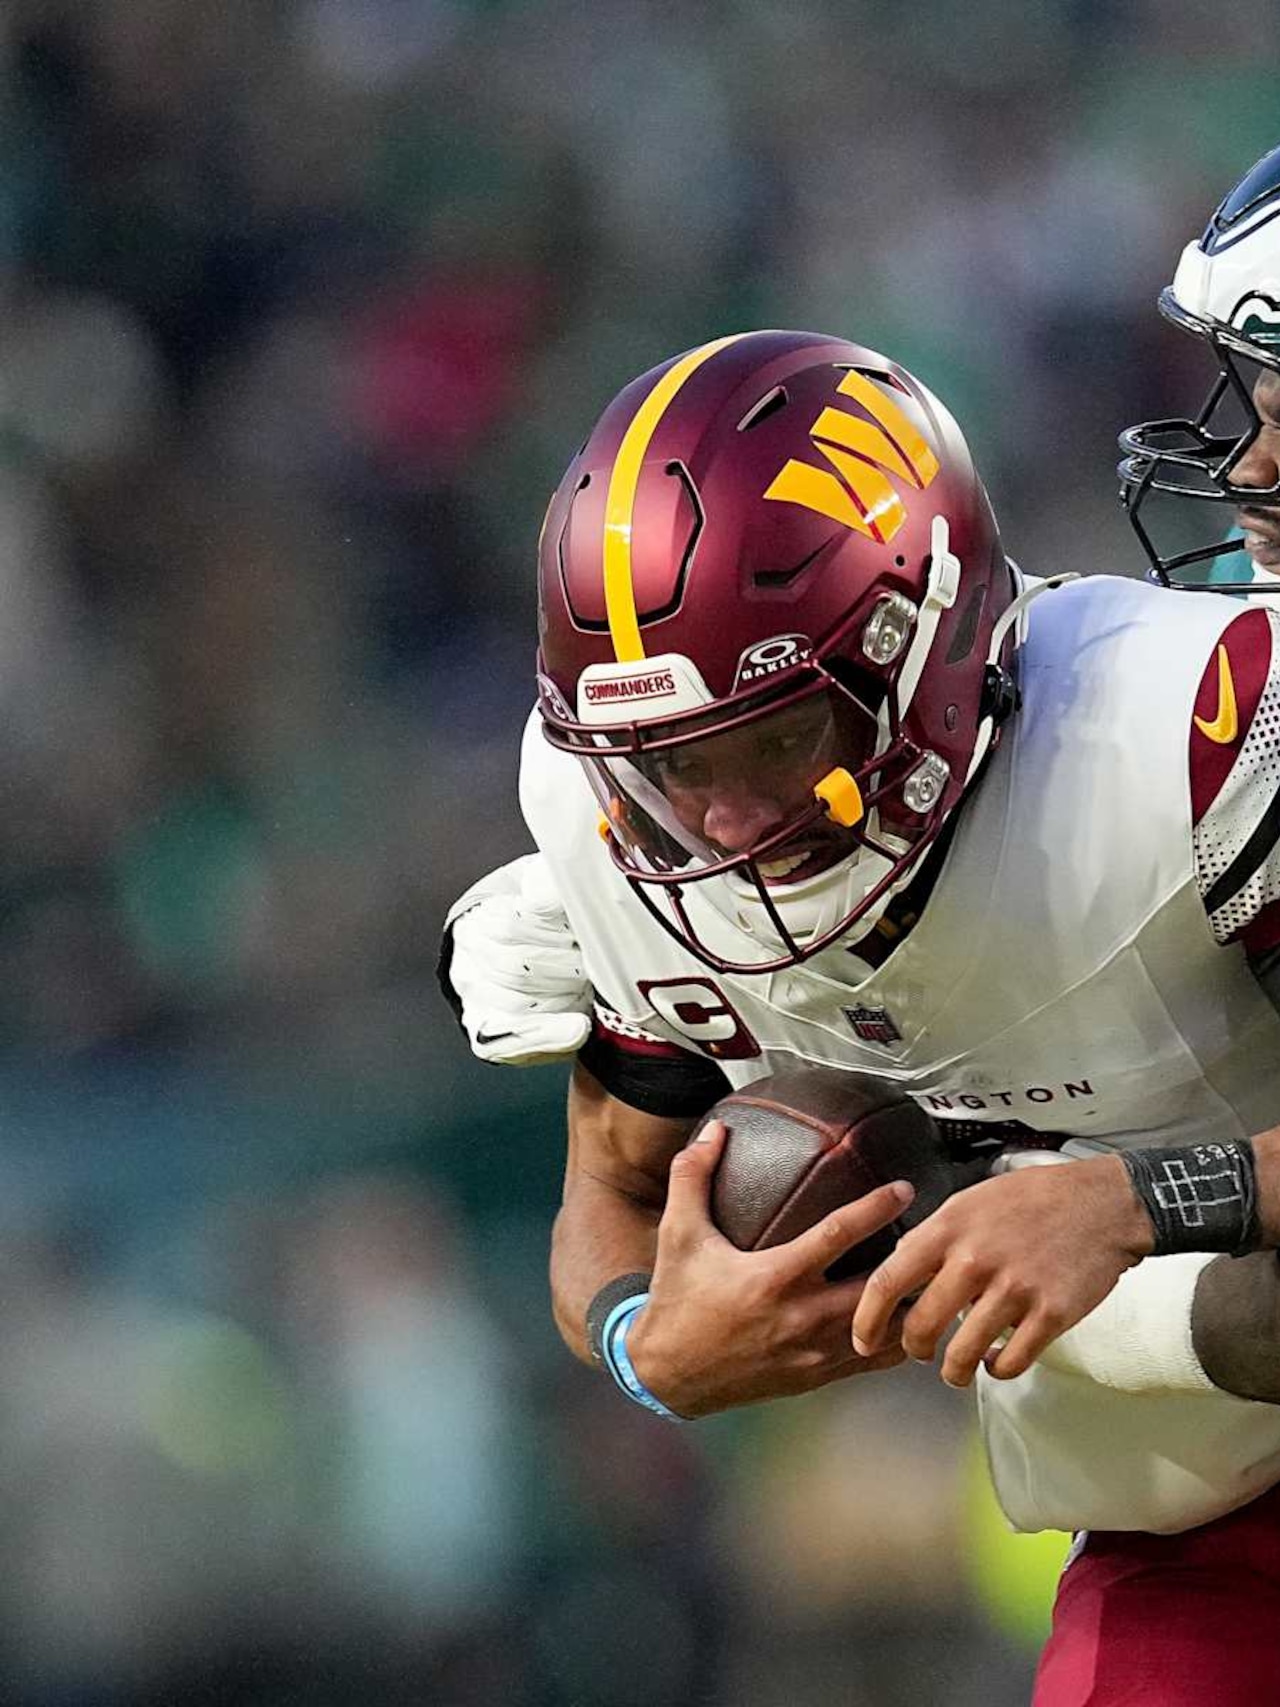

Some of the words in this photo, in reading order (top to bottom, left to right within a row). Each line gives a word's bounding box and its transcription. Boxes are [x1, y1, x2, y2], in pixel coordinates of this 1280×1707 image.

[741, 649, 810, 681] OAKLEY
[584, 673, 676, 701] COMMANDERS
[648, 983, 737, 1041] C
[926, 1079, 1094, 1111] NGTON
